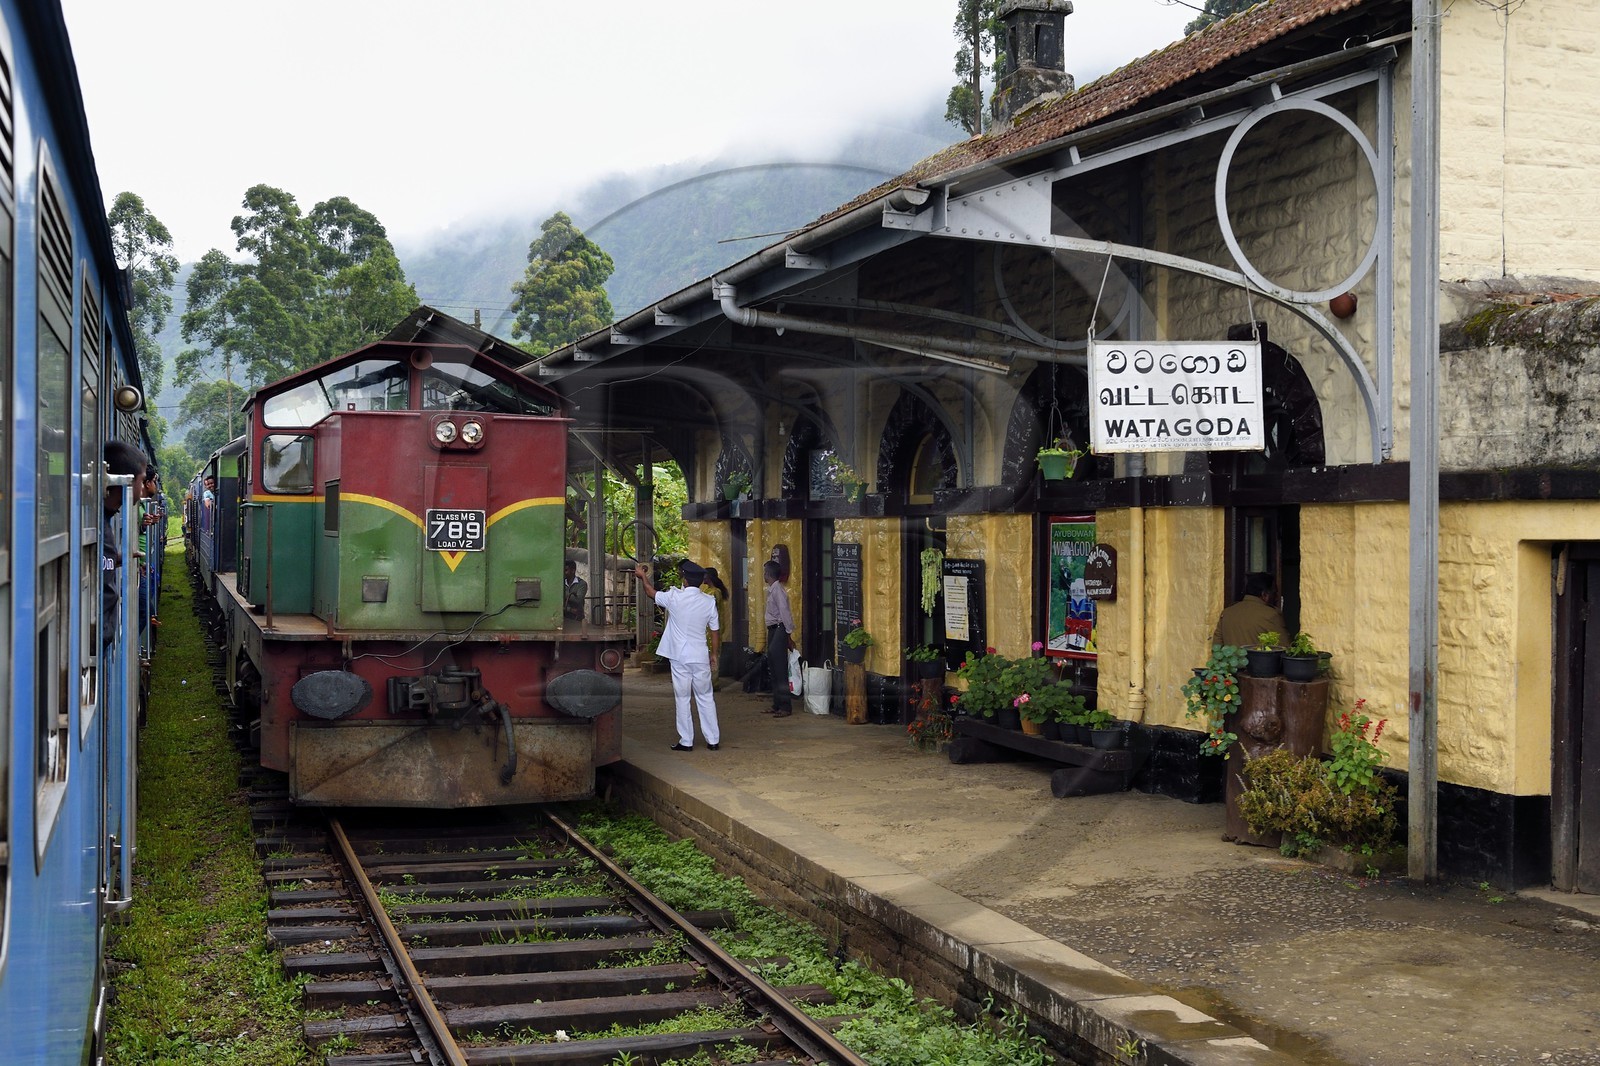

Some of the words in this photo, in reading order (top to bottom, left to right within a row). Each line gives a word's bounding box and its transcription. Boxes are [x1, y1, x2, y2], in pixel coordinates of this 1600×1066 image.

[1106, 349, 1247, 374] වටගොඩ
[1104, 417, 1251, 438] WATAGODA
[461, 512, 476, 521] M6
[430, 521, 480, 539] 789
[1053, 530, 1094, 538] AYUBOWAN
[458, 540, 473, 548] V2
